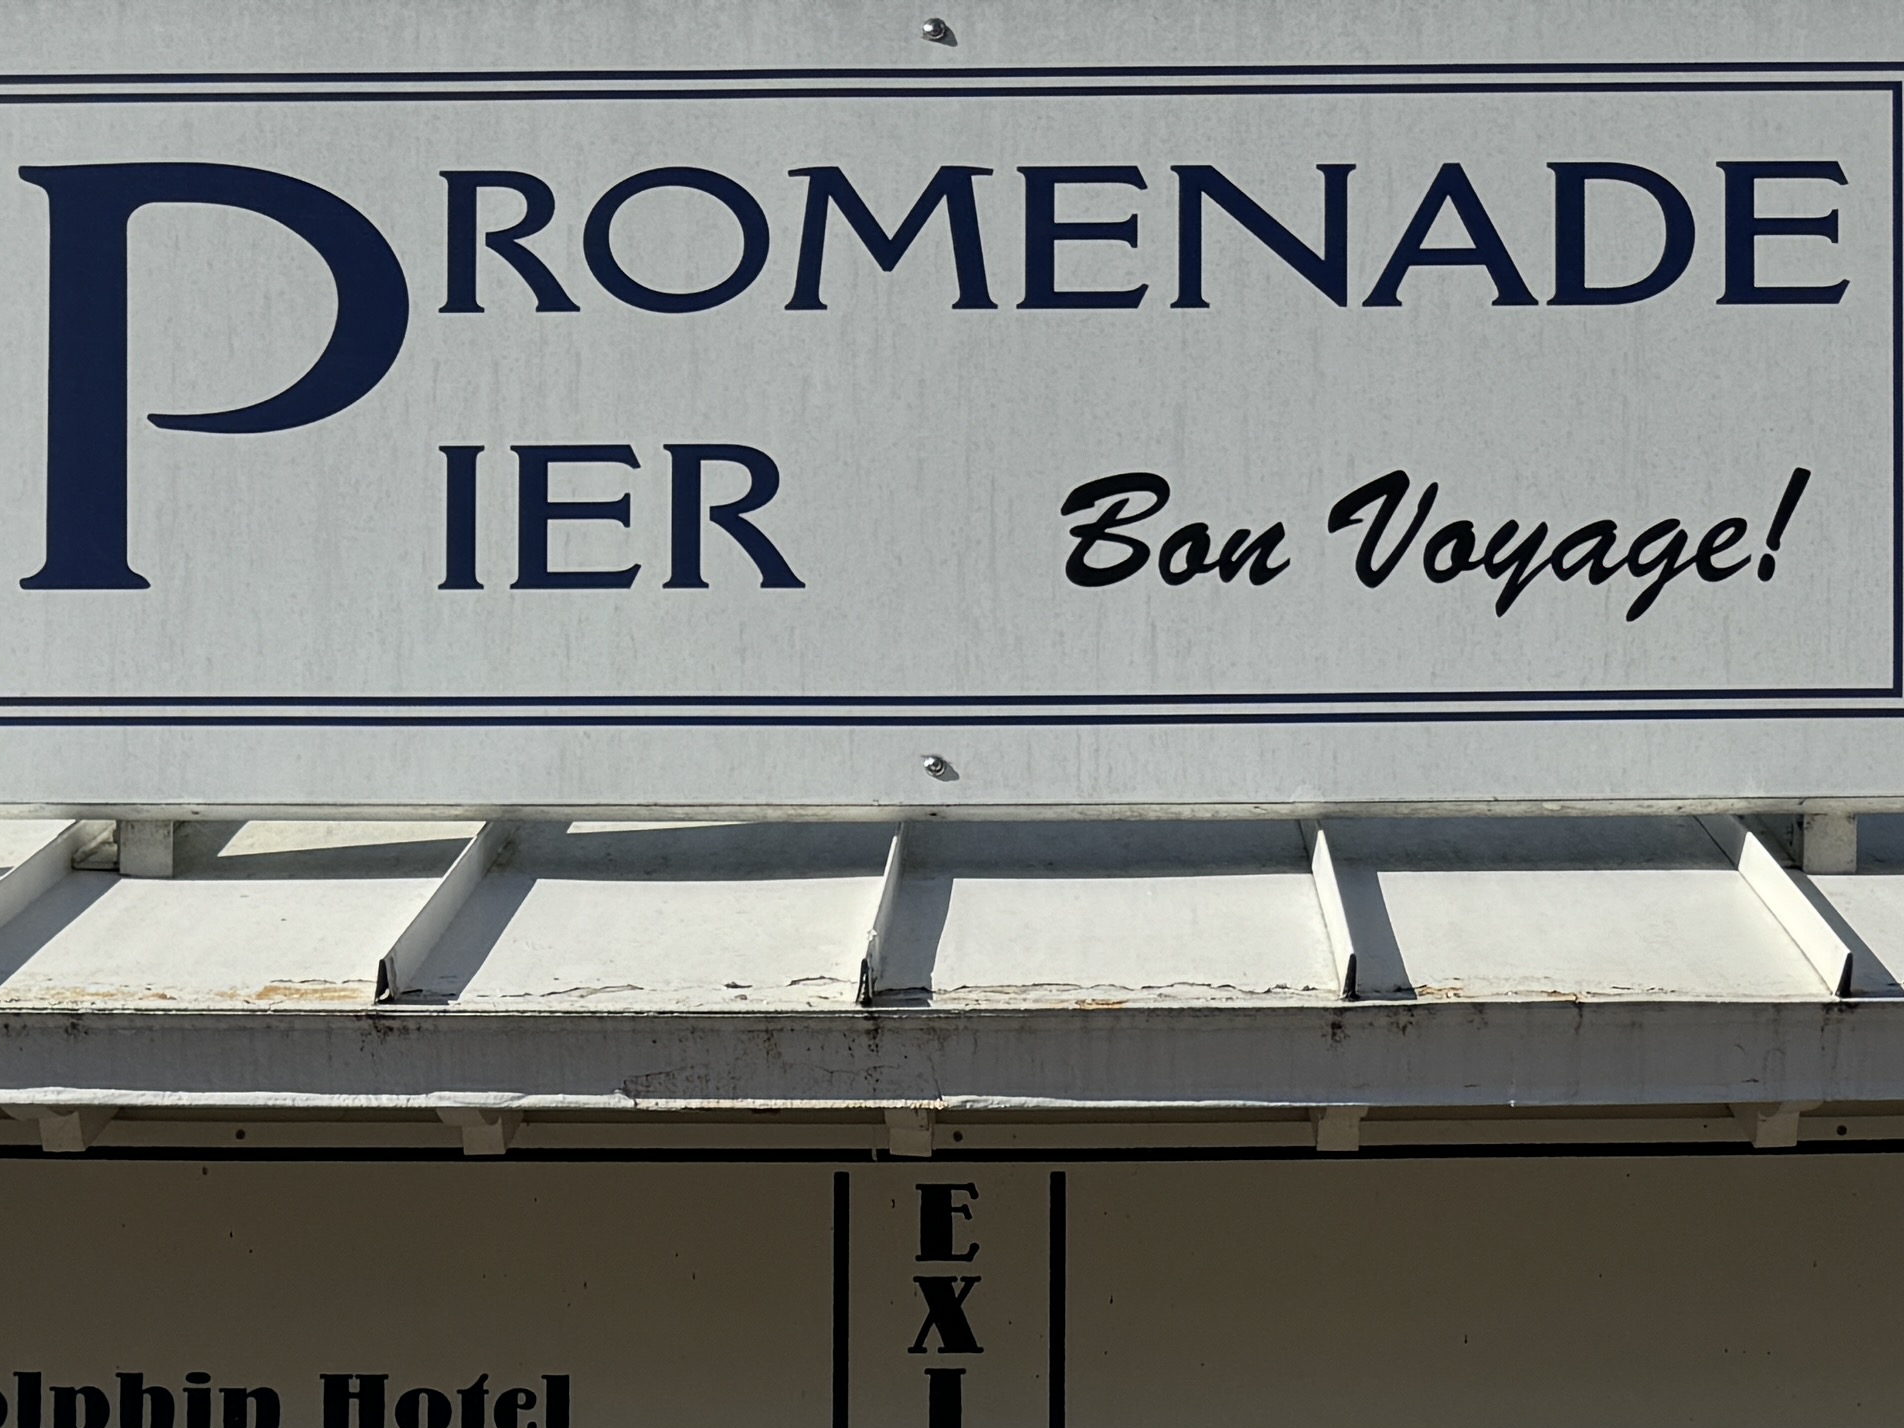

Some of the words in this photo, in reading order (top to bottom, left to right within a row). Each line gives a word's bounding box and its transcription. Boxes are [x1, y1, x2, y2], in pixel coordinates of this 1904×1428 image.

[19, 161, 1850, 589] PROMENADE
[1061, 473, 1290, 587] Bon
[1328, 468, 1811, 621] Voyage!
